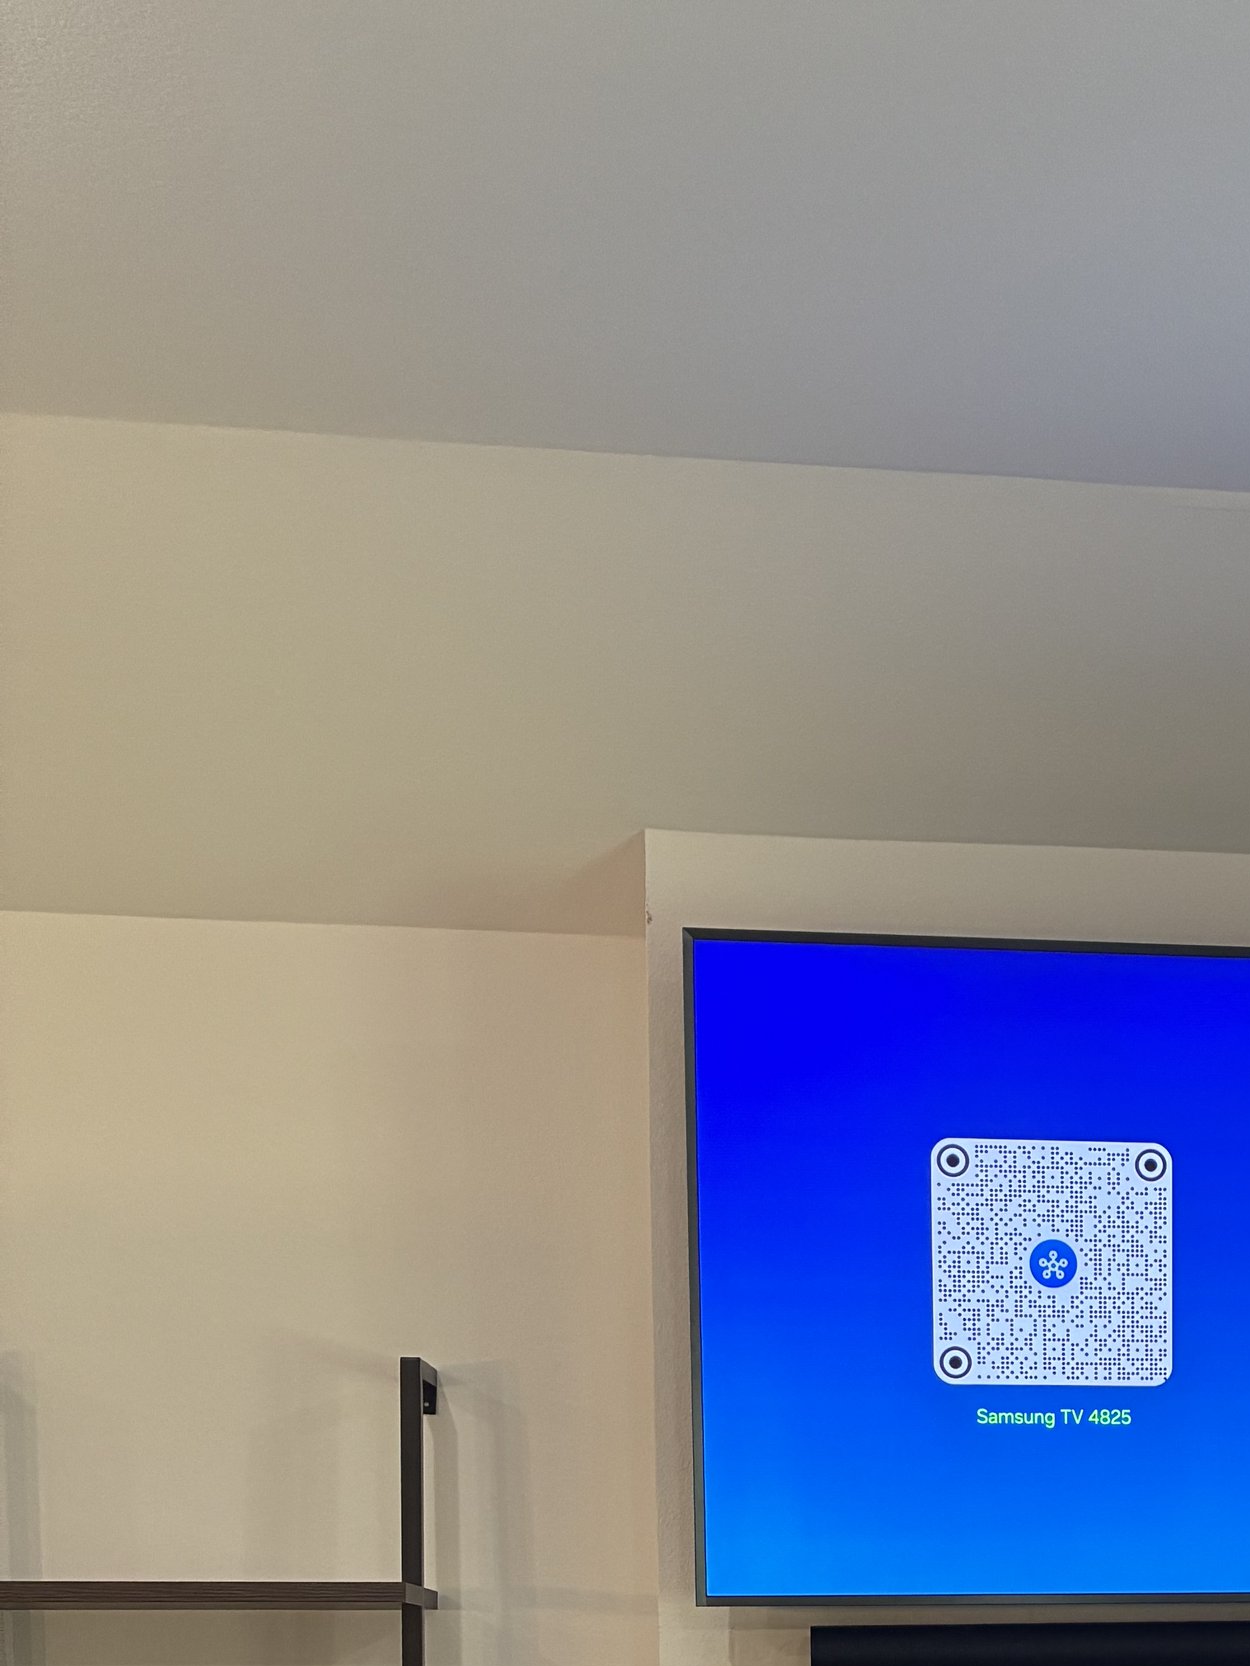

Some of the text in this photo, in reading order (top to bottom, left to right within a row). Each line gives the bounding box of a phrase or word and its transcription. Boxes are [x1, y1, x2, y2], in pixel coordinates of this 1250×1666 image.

[976, 1408, 1132, 1428] Samsung TV 4825
